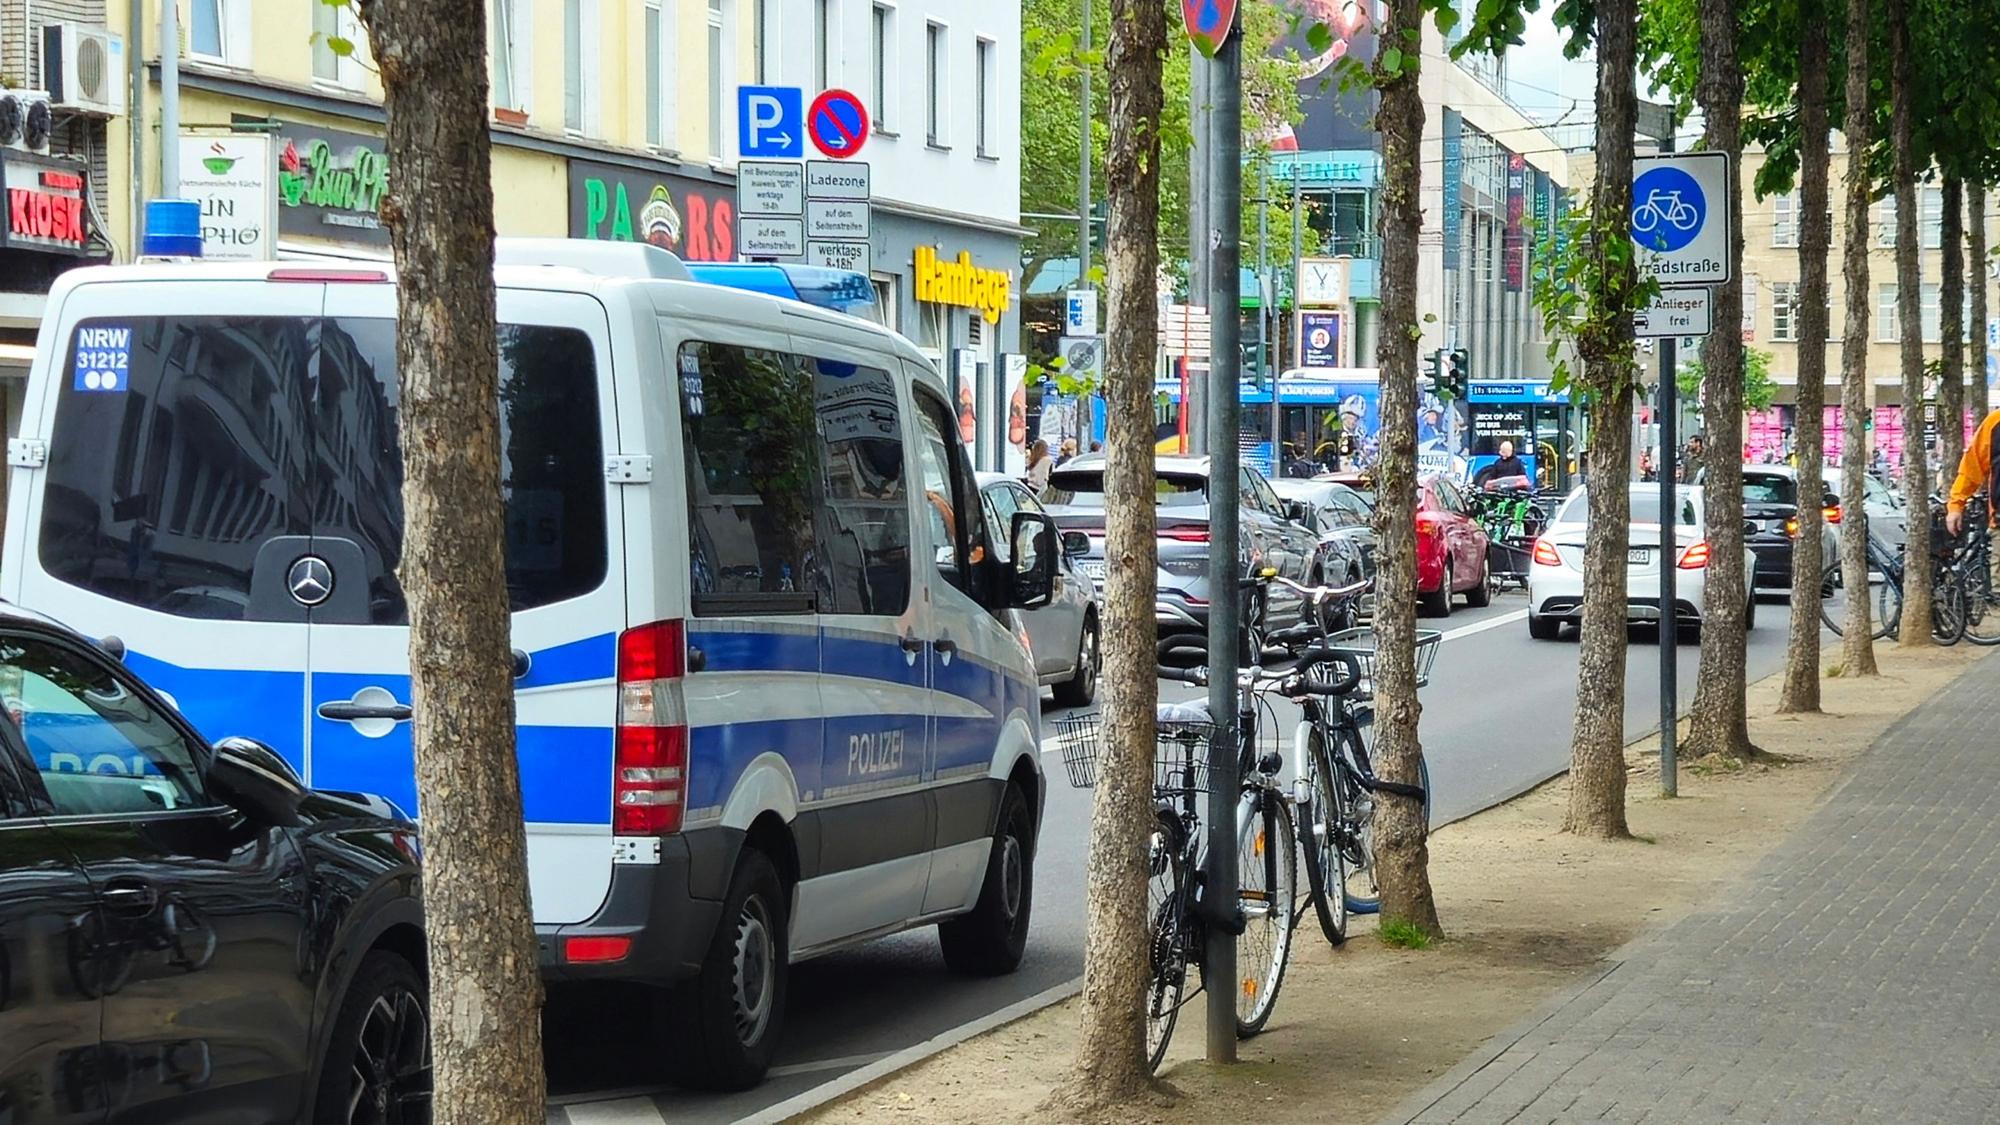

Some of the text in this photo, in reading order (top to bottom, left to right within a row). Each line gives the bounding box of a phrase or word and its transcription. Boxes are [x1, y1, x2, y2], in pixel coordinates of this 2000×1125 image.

[748, 95, 783, 148] P
[810, 174, 866, 188] Ladezone
[197, 193, 234, 217] ÚN
[10, 187, 84, 244] KIOSK
[825, 209, 853, 218] auf dem
[758, 229, 786, 237] auf dem
[815, 221, 863, 231] Seitenstreifen
[748, 240, 796, 250] Seitenstreifen
[818, 244, 862, 260] werktags
[1654, 298, 1704, 311] Anlieger
[1669, 315, 1690, 326] frei
[79, 328, 129, 348] NRW
[77, 351, 128, 369] 31212
[848, 729, 904, 776] POLIZEI
